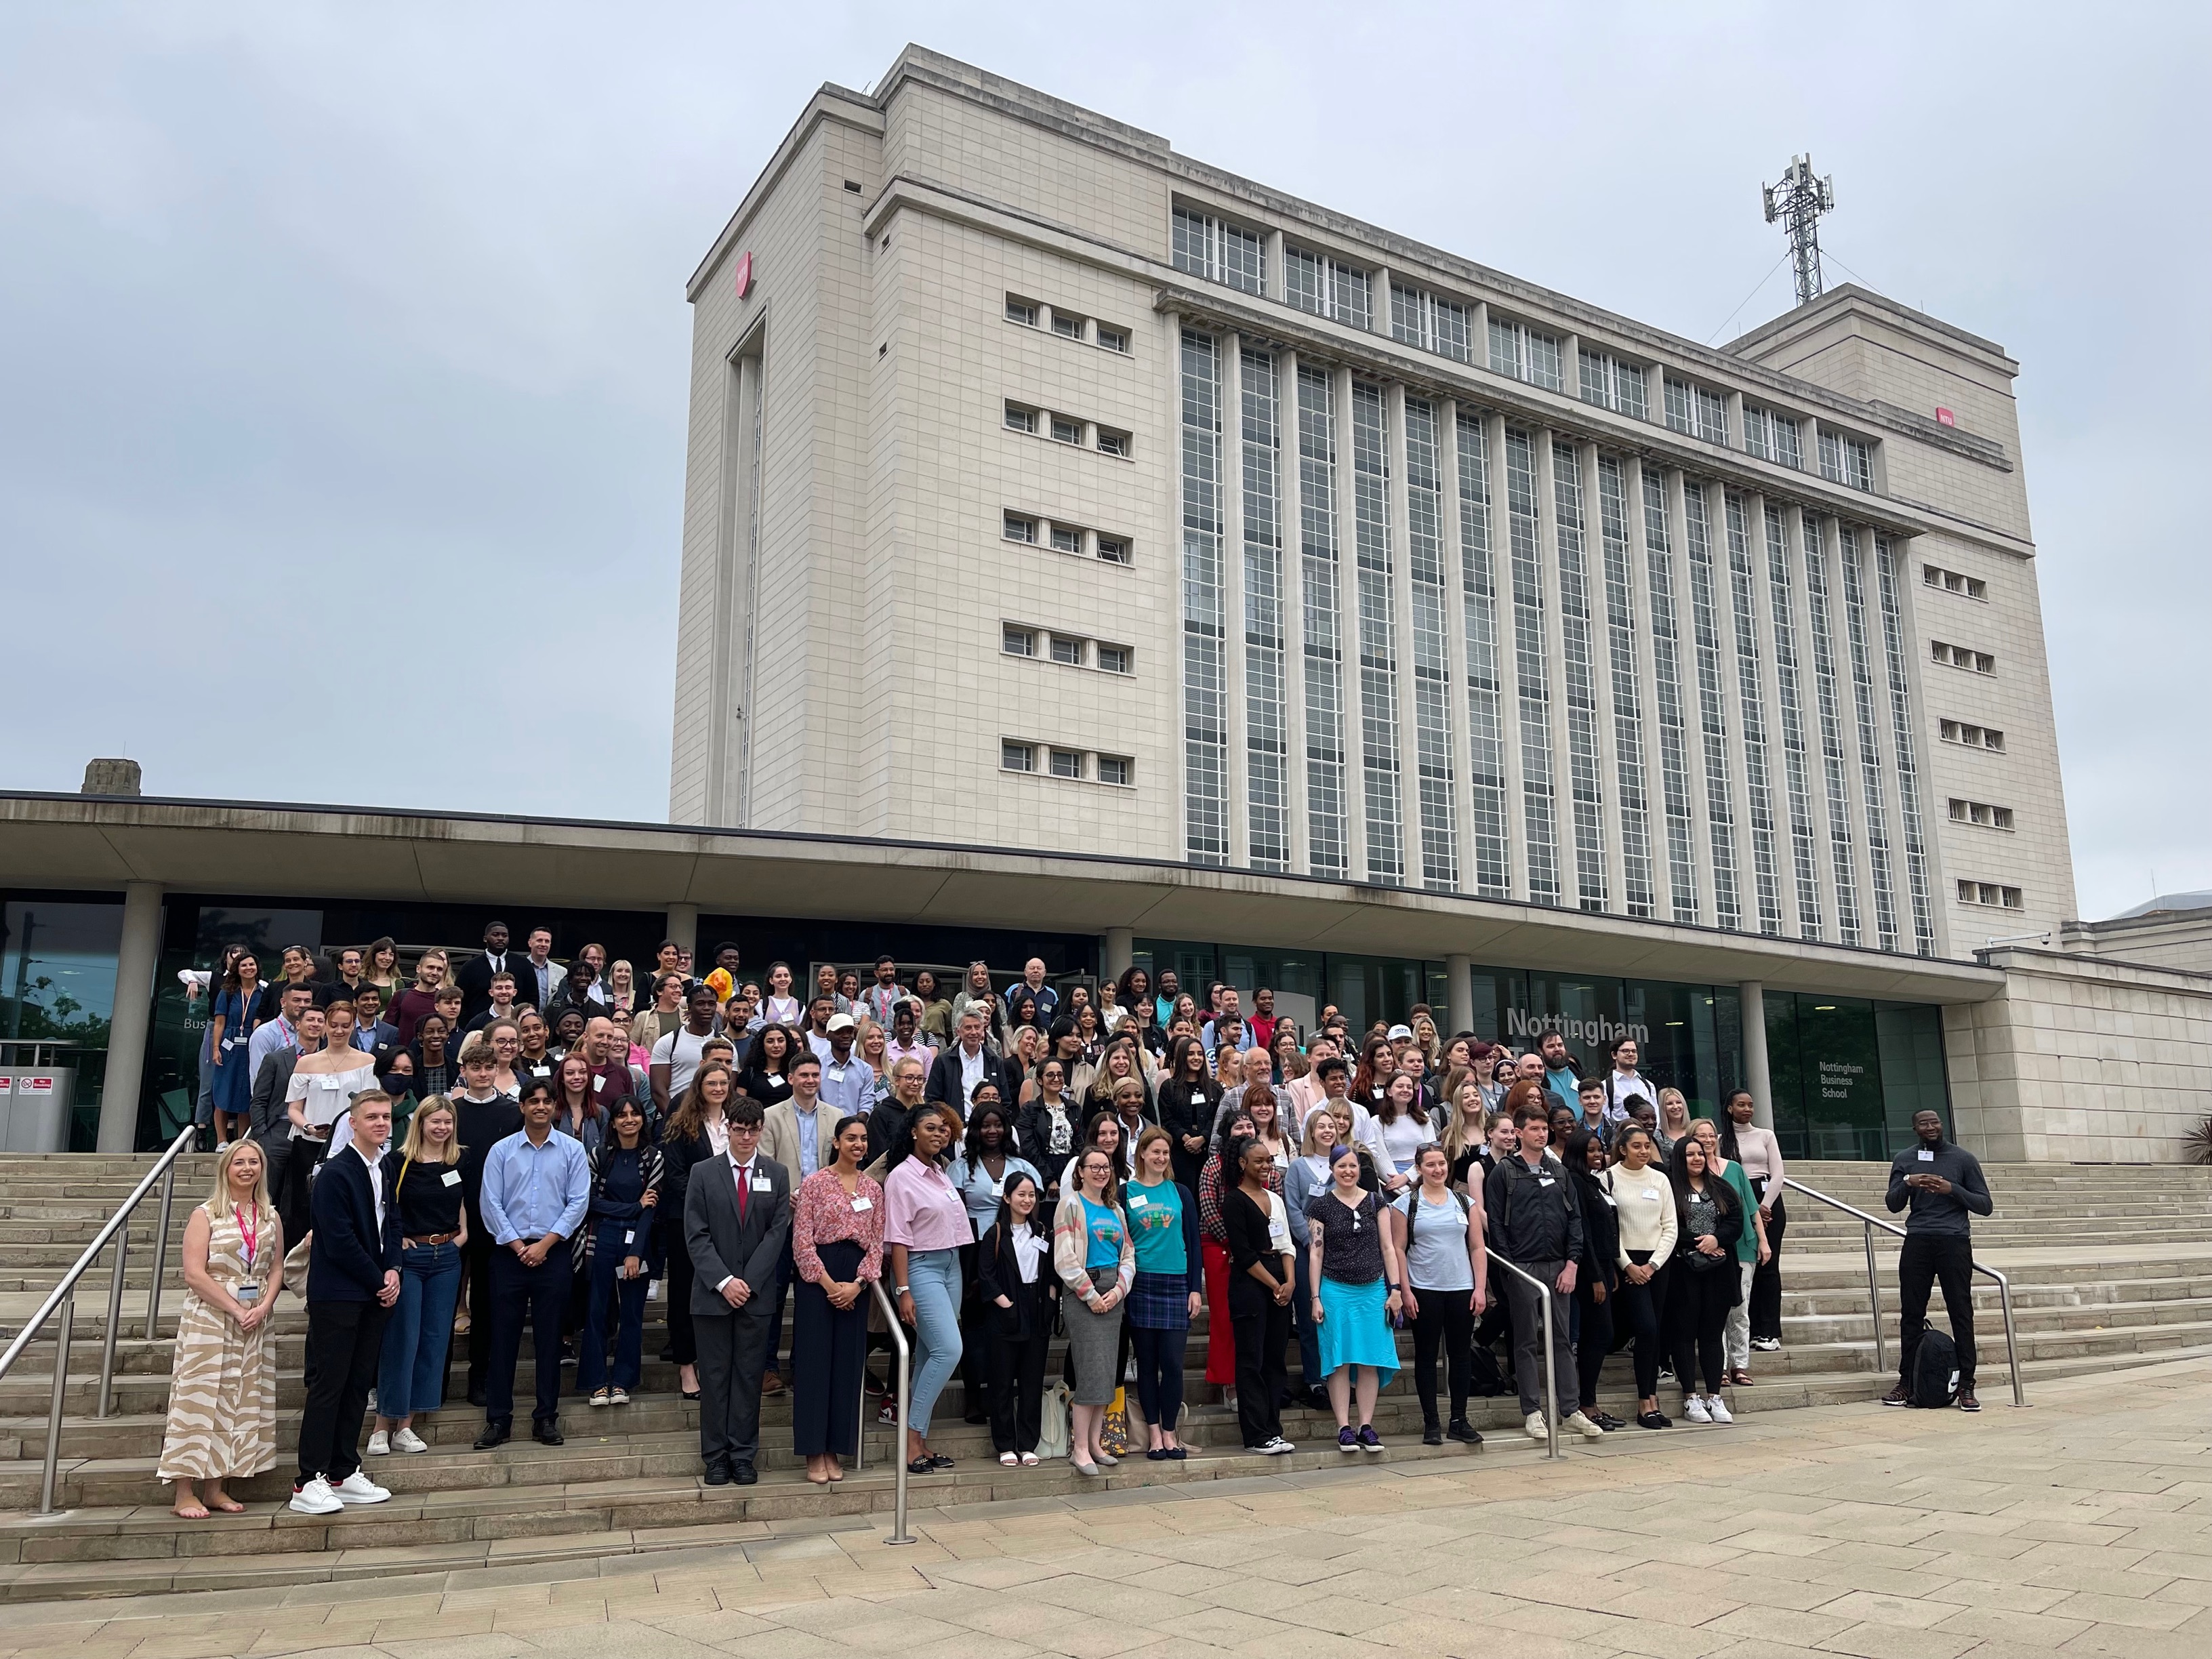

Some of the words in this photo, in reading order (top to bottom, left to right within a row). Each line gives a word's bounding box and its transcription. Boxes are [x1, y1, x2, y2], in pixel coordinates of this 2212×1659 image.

[738, 264, 747, 283] NTU
[1940, 414, 1952, 425] NTU
[1507, 1008, 1649, 1047] Nottingham
[1820, 1061, 1863, 1075] Nottingham
[1821, 1074, 1853, 1085] Business
[1822, 1087, 1847, 1099] School
